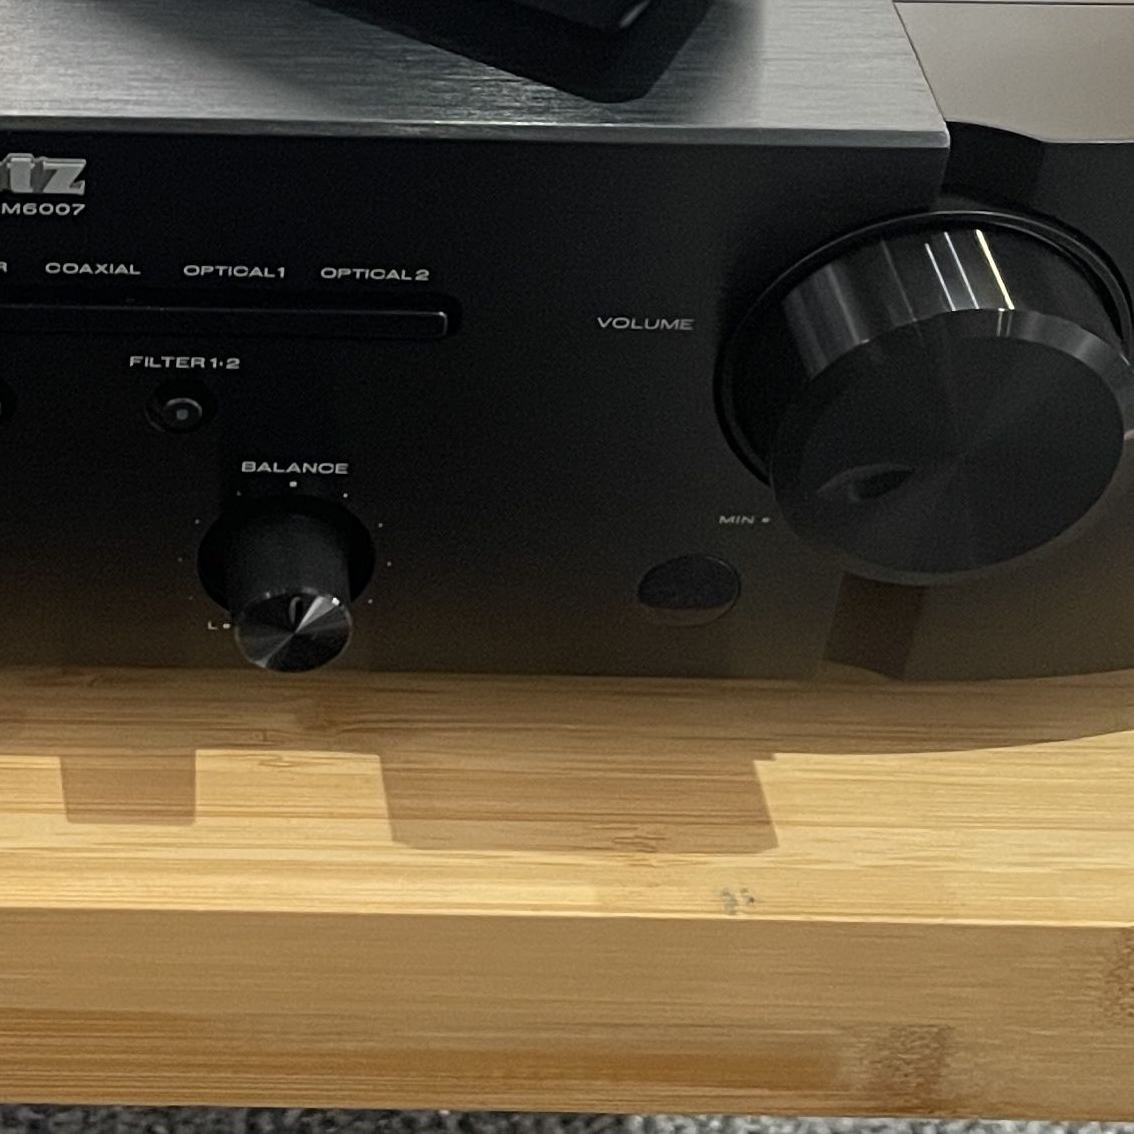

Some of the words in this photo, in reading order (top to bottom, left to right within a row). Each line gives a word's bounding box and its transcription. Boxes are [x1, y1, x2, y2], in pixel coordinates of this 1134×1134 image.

[45, 262, 141, 275] COAXIAL
[597, 316, 694, 331] VOLUME
[241, 460, 349, 475] BALANCE
[718, 515, 755, 526] MIN
